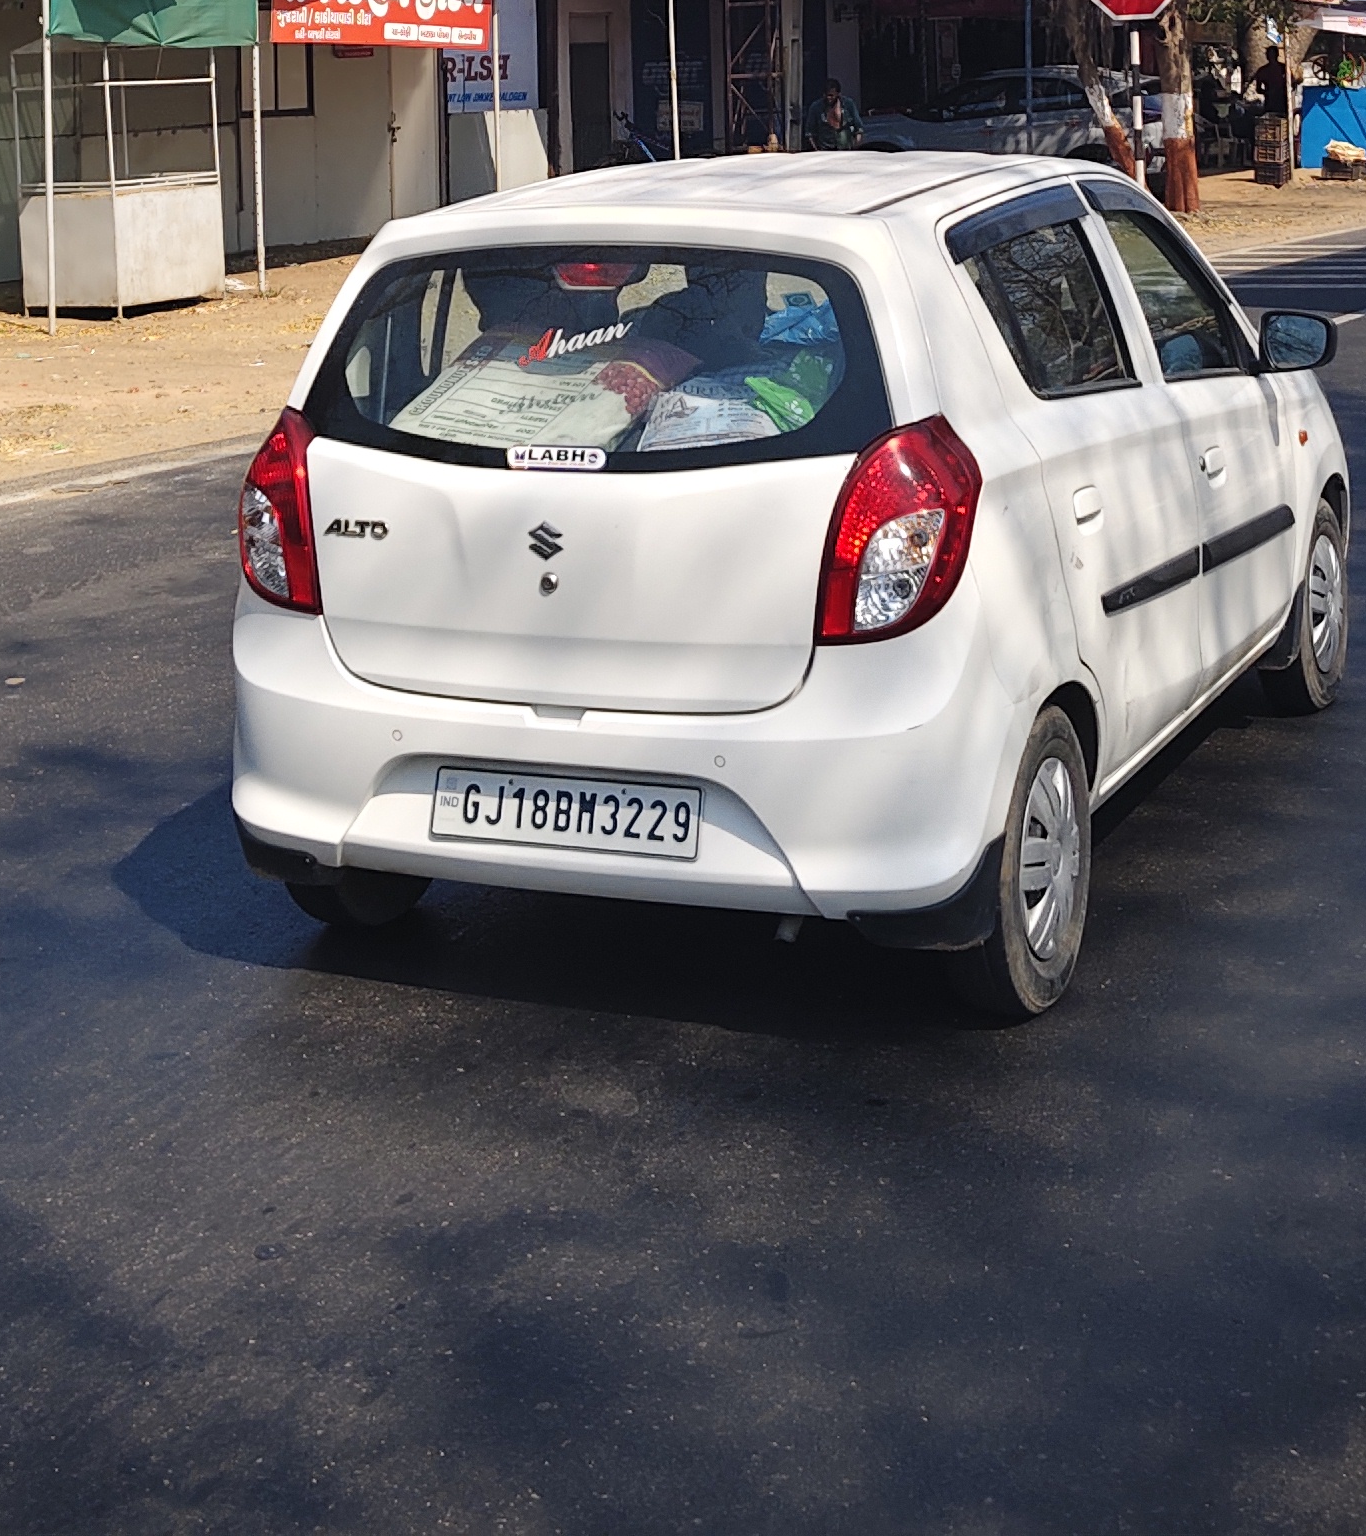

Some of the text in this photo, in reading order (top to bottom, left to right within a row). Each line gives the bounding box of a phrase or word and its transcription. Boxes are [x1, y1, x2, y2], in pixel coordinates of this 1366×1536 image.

[499, 91, 528, 102] ALOGEN
[517, 321, 634, 368] Ahaan
[528, 449, 586, 463] LABH
[323, 518, 390, 541] ALTO
[439, 783, 691, 844] IND GJ18BM3229
